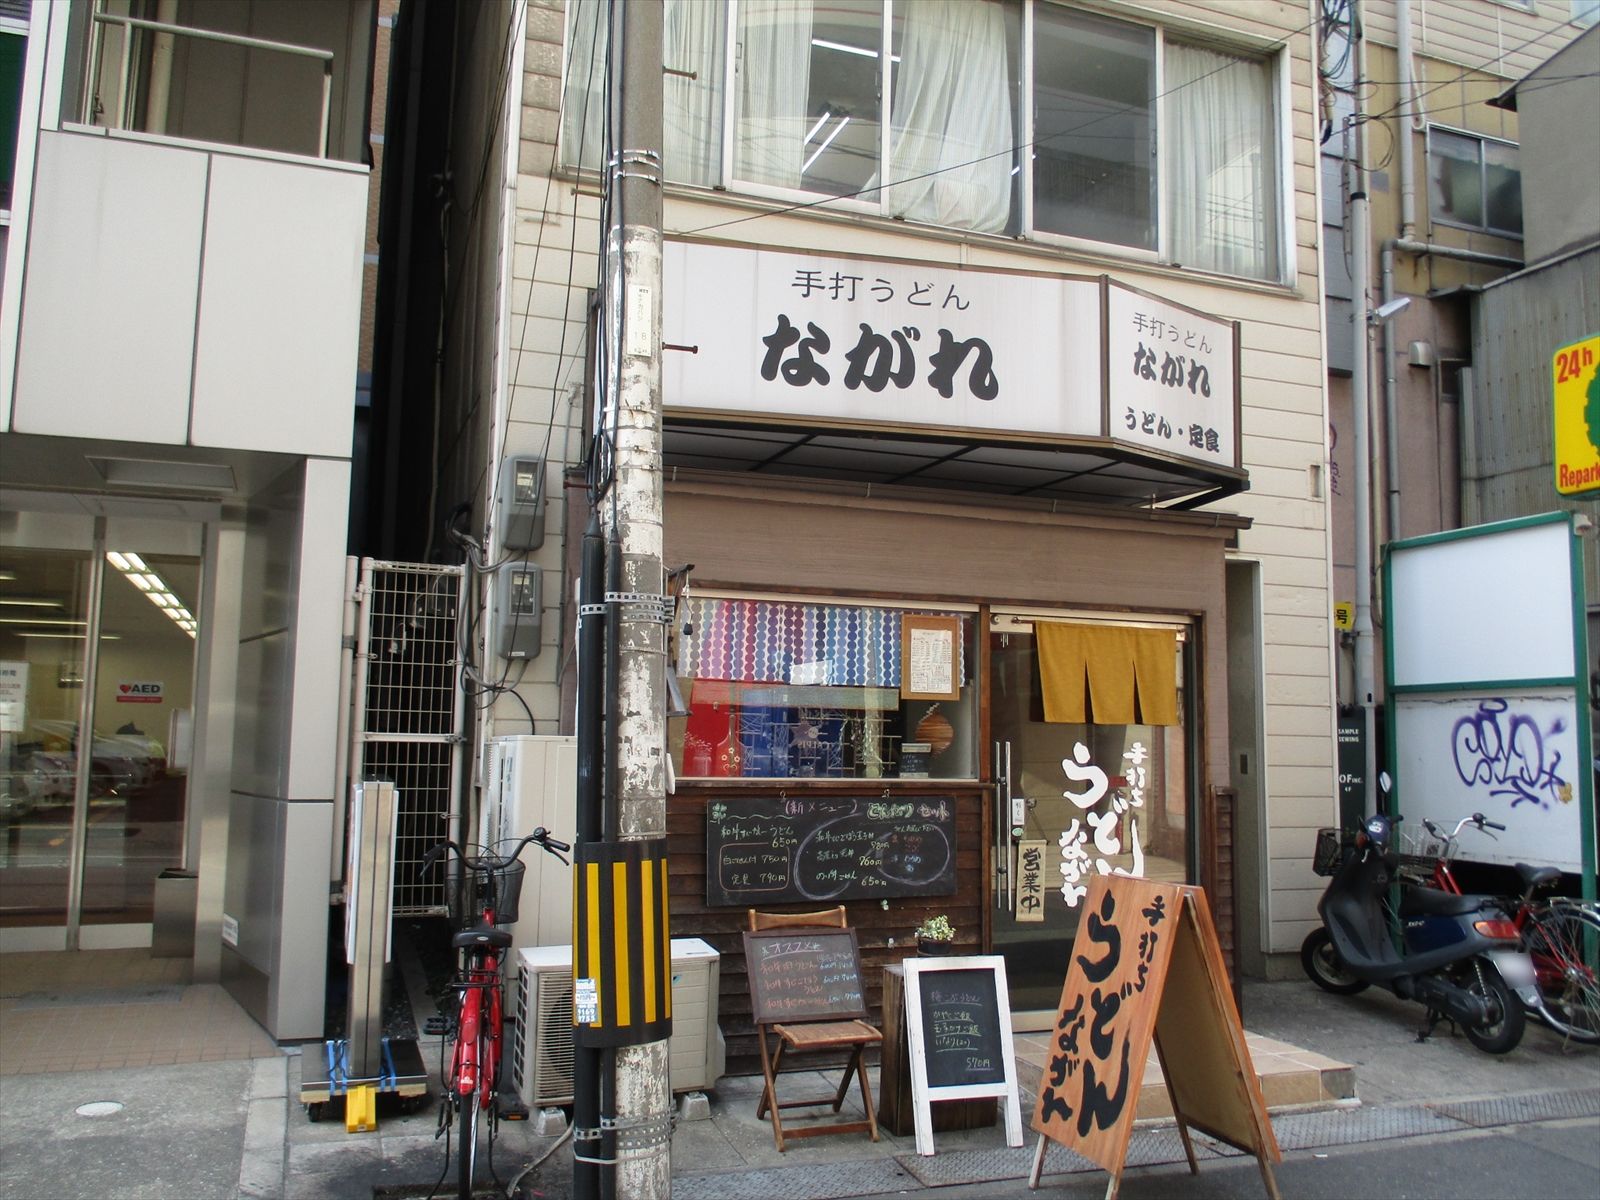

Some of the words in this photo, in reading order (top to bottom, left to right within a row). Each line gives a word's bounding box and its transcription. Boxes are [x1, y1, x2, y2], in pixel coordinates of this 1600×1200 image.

[792, 270, 970, 310] 手打うどん
[761, 314, 998, 400] ながれ
[1133, 312, 1212, 354] 手打うどん
[1133, 342, 1210, 398] ながれ
[1125, 406, 1219, 453] うどん・定食
[131, 684, 161, 693] AED
[1123, 742, 1149, 807] 手打ち
[1021, 847, 1041, 914] 営業中
[1134, 895, 1166, 993] 手打ち
[1076, 889, 1133, 1137] うどん
[1042, 994, 1086, 1123] ながれ
